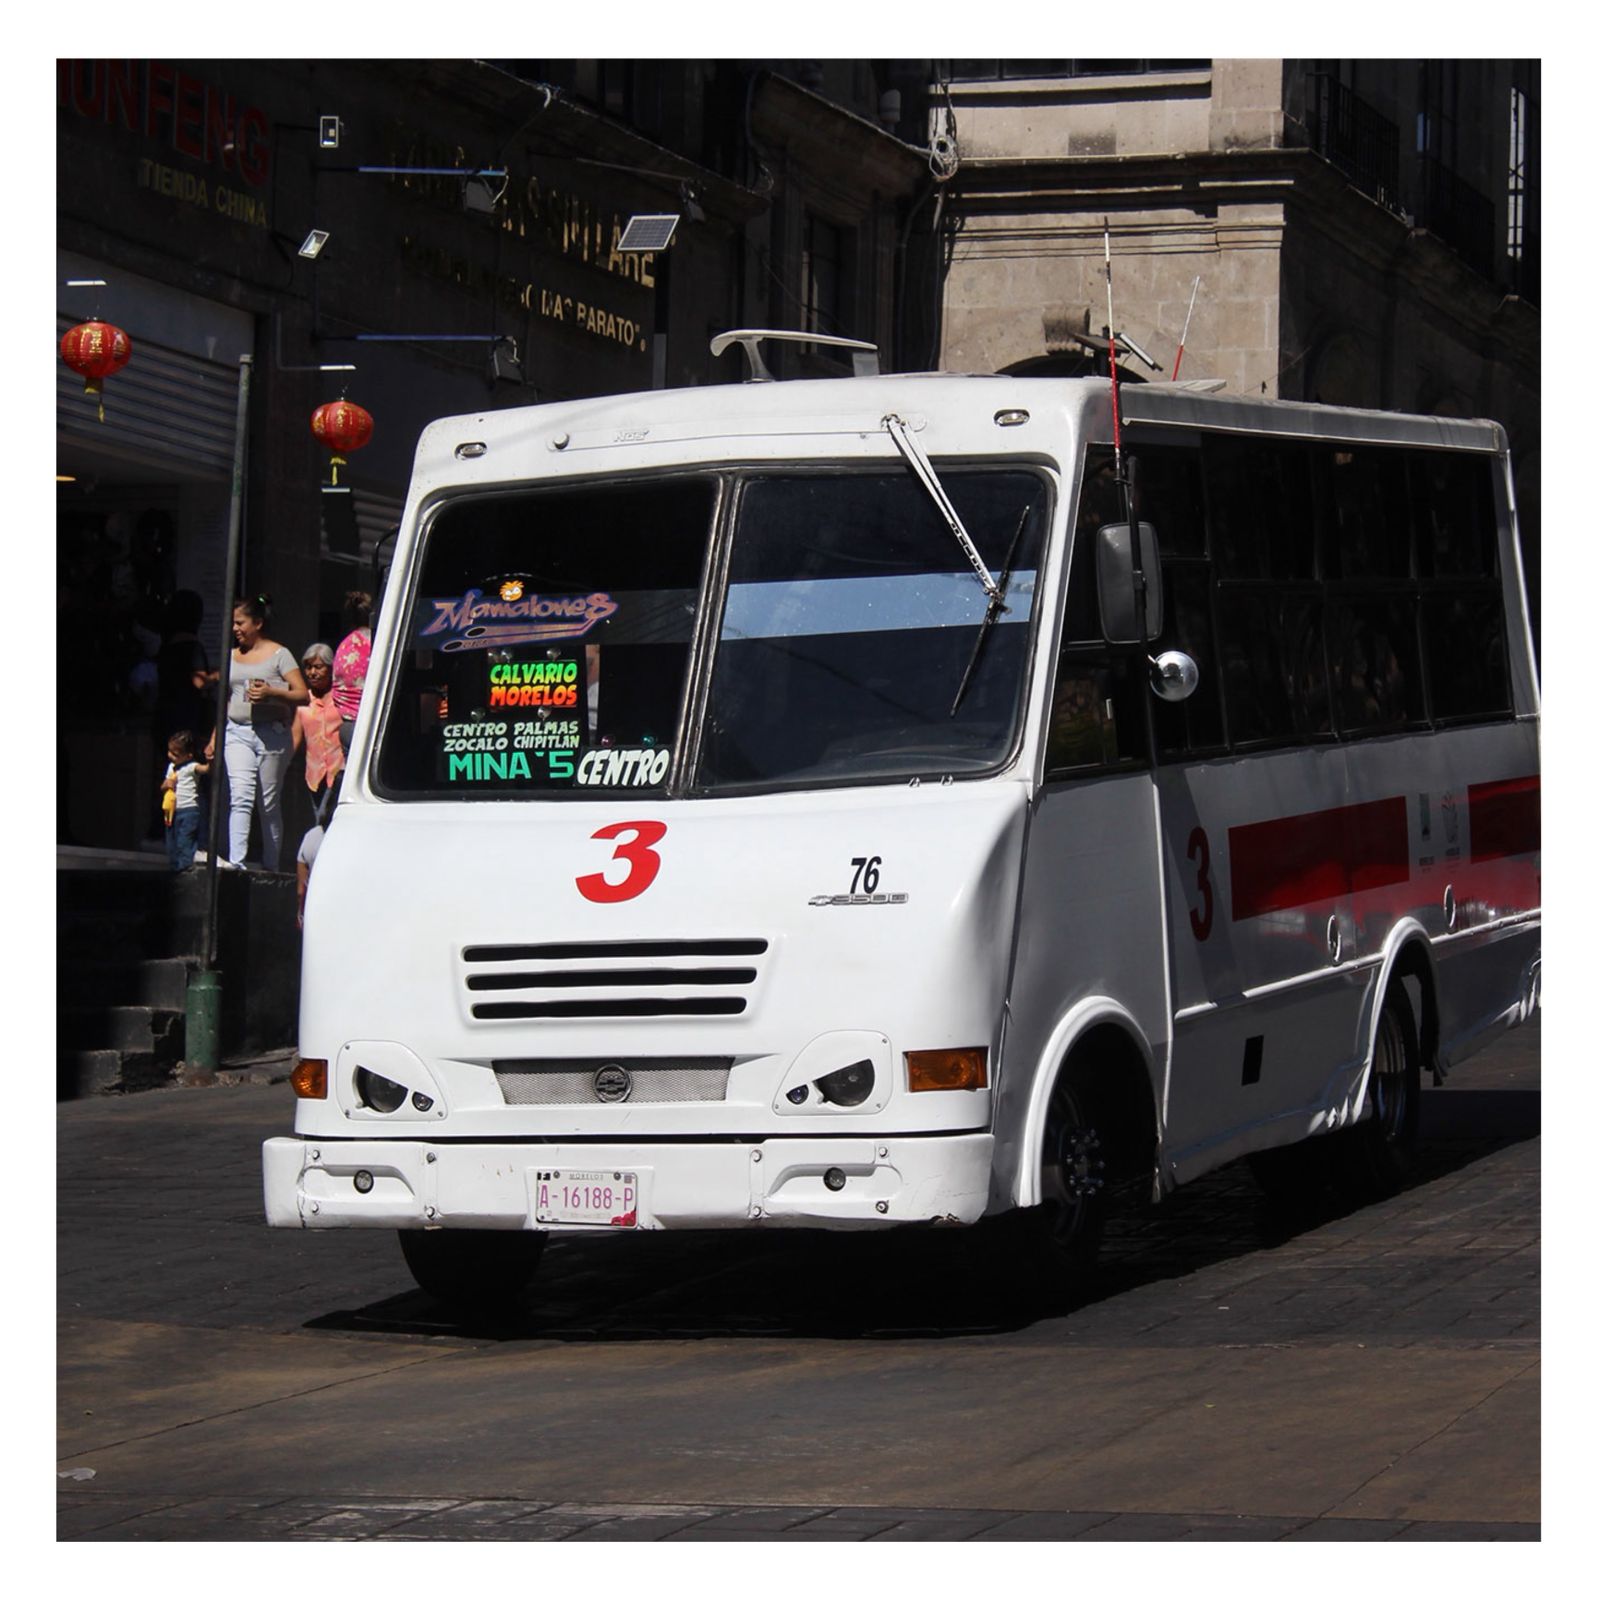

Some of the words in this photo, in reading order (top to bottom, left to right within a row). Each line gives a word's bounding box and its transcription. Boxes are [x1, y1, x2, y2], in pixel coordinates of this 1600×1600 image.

[139, 158, 209, 209] TIENDA
[215, 184, 268, 227] CHINA
[489, 661, 578, 685] CALVARIO
[489, 684, 578, 707] MORELOS
[443, 722, 508, 738] CENTRO
[513, 720, 579, 737] PALMAS
[443, 737, 509, 752] ZOCALO
[513, 735, 580, 750] CHIPITLAN
[576, 749, 670, 787] CENTRO
[575, 820, 668, 905] 3
[849, 855, 883, 895] 76
[1187, 826, 1214, 942] 3
[539, 1184, 634, 1212] A-16188-P
